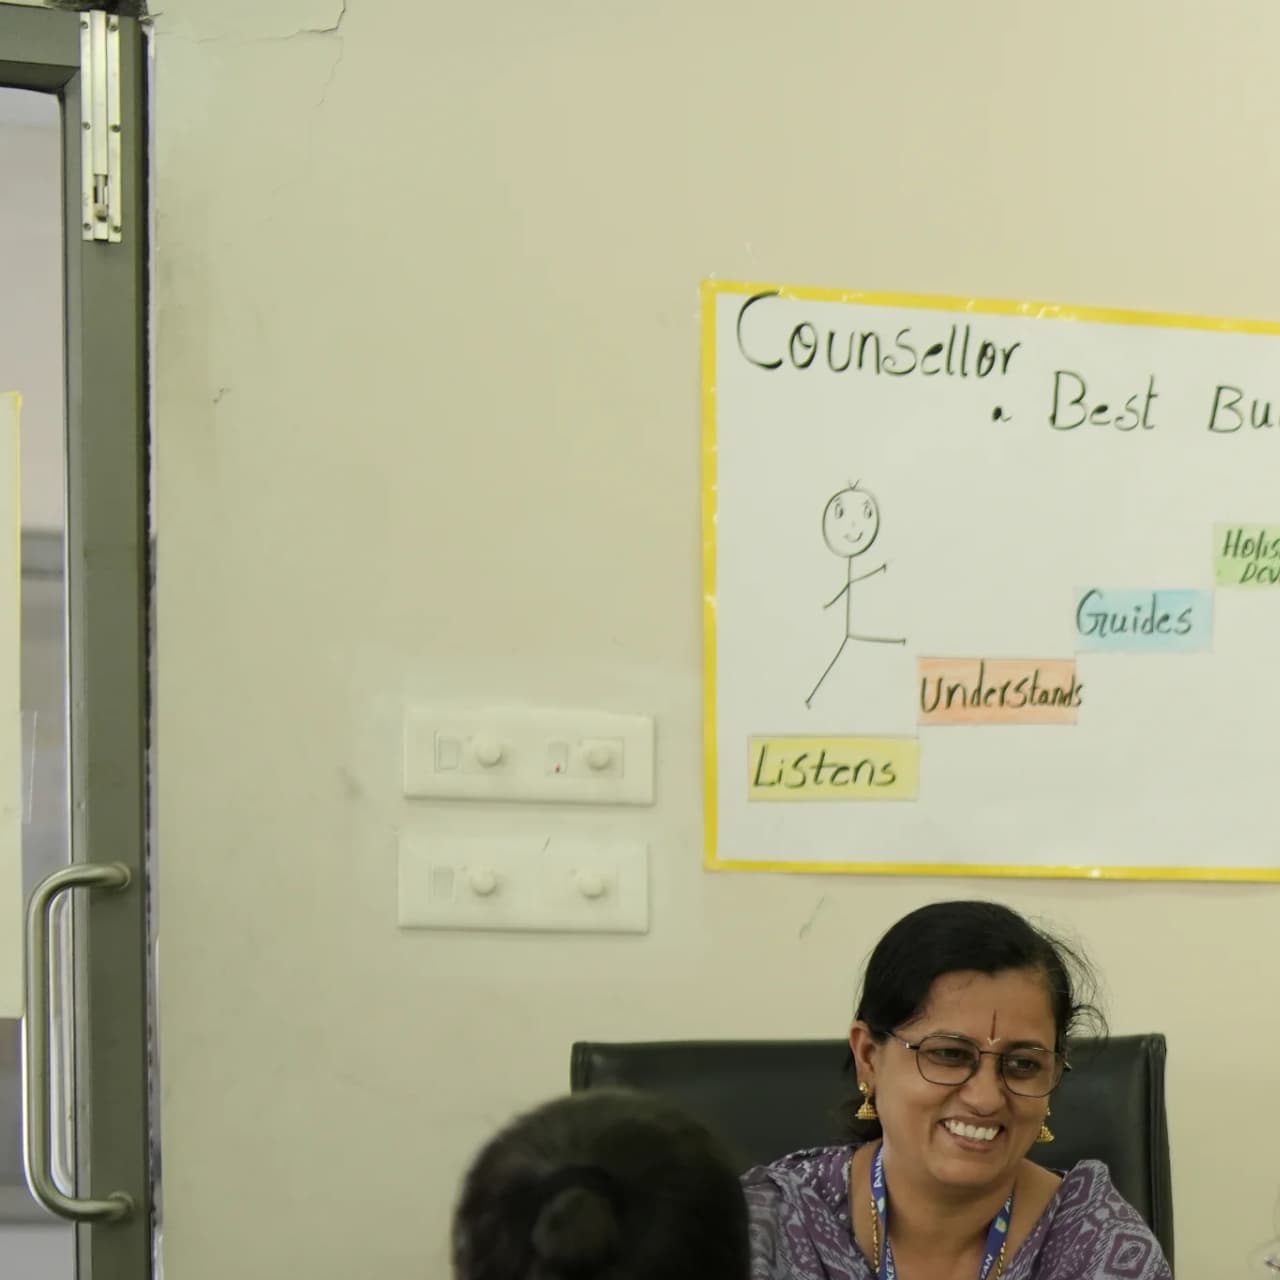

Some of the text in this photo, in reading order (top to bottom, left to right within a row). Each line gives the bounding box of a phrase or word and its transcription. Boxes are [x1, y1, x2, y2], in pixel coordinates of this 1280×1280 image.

[736, 290, 1021, 378] Counsellor
[1048, 370, 1158, 431] Best
[1076, 588, 1192, 637] Guides
[921, 658, 1083, 713] Understands
[753, 745, 897, 788] Listens
